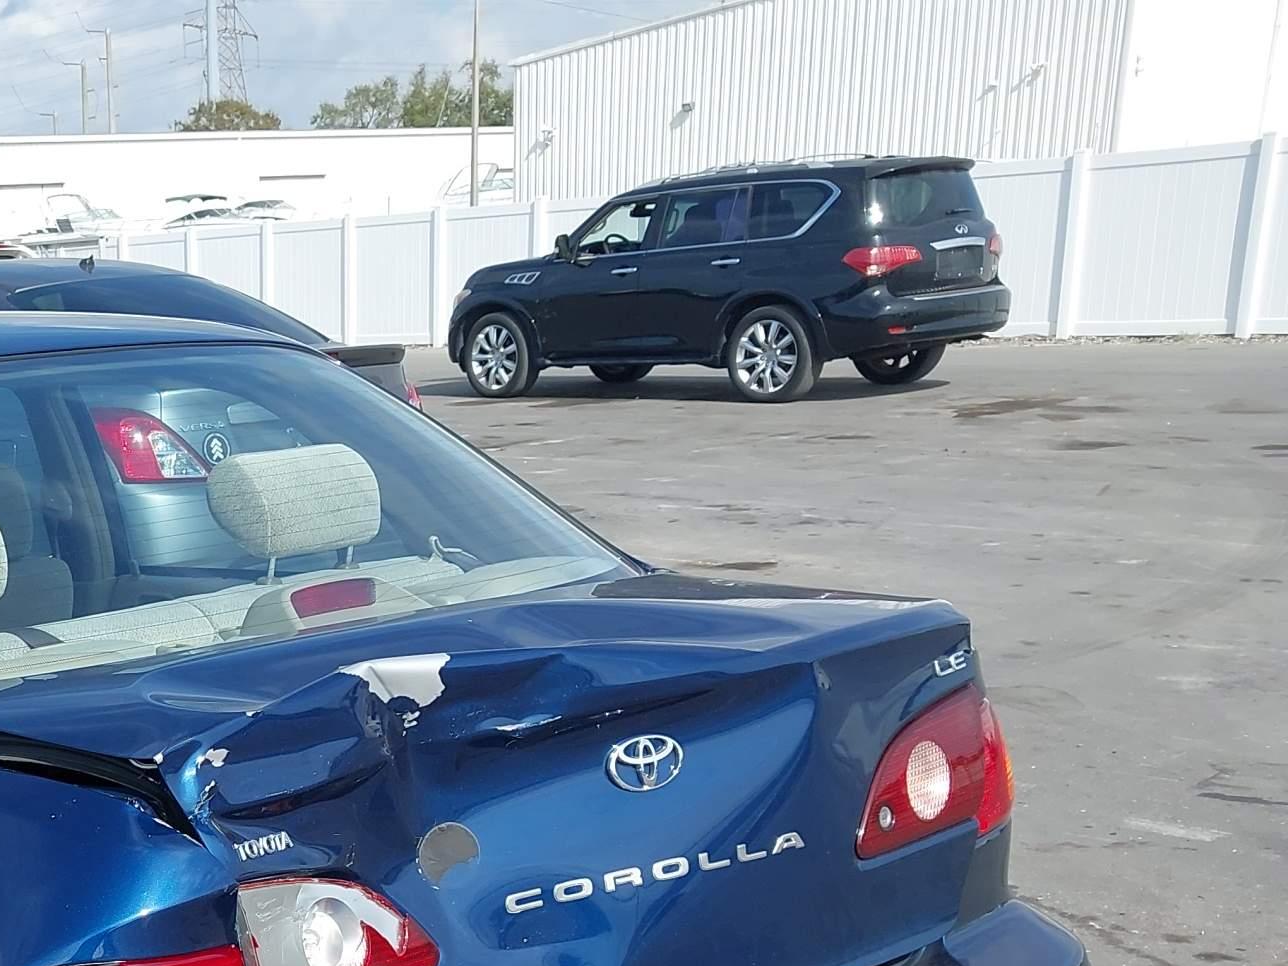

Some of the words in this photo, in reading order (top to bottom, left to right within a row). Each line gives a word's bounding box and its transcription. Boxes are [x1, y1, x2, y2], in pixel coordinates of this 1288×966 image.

[934, 650, 967, 676] LE
[232, 831, 294, 861] TOYOTA
[505, 831, 805, 914] COROLLA
